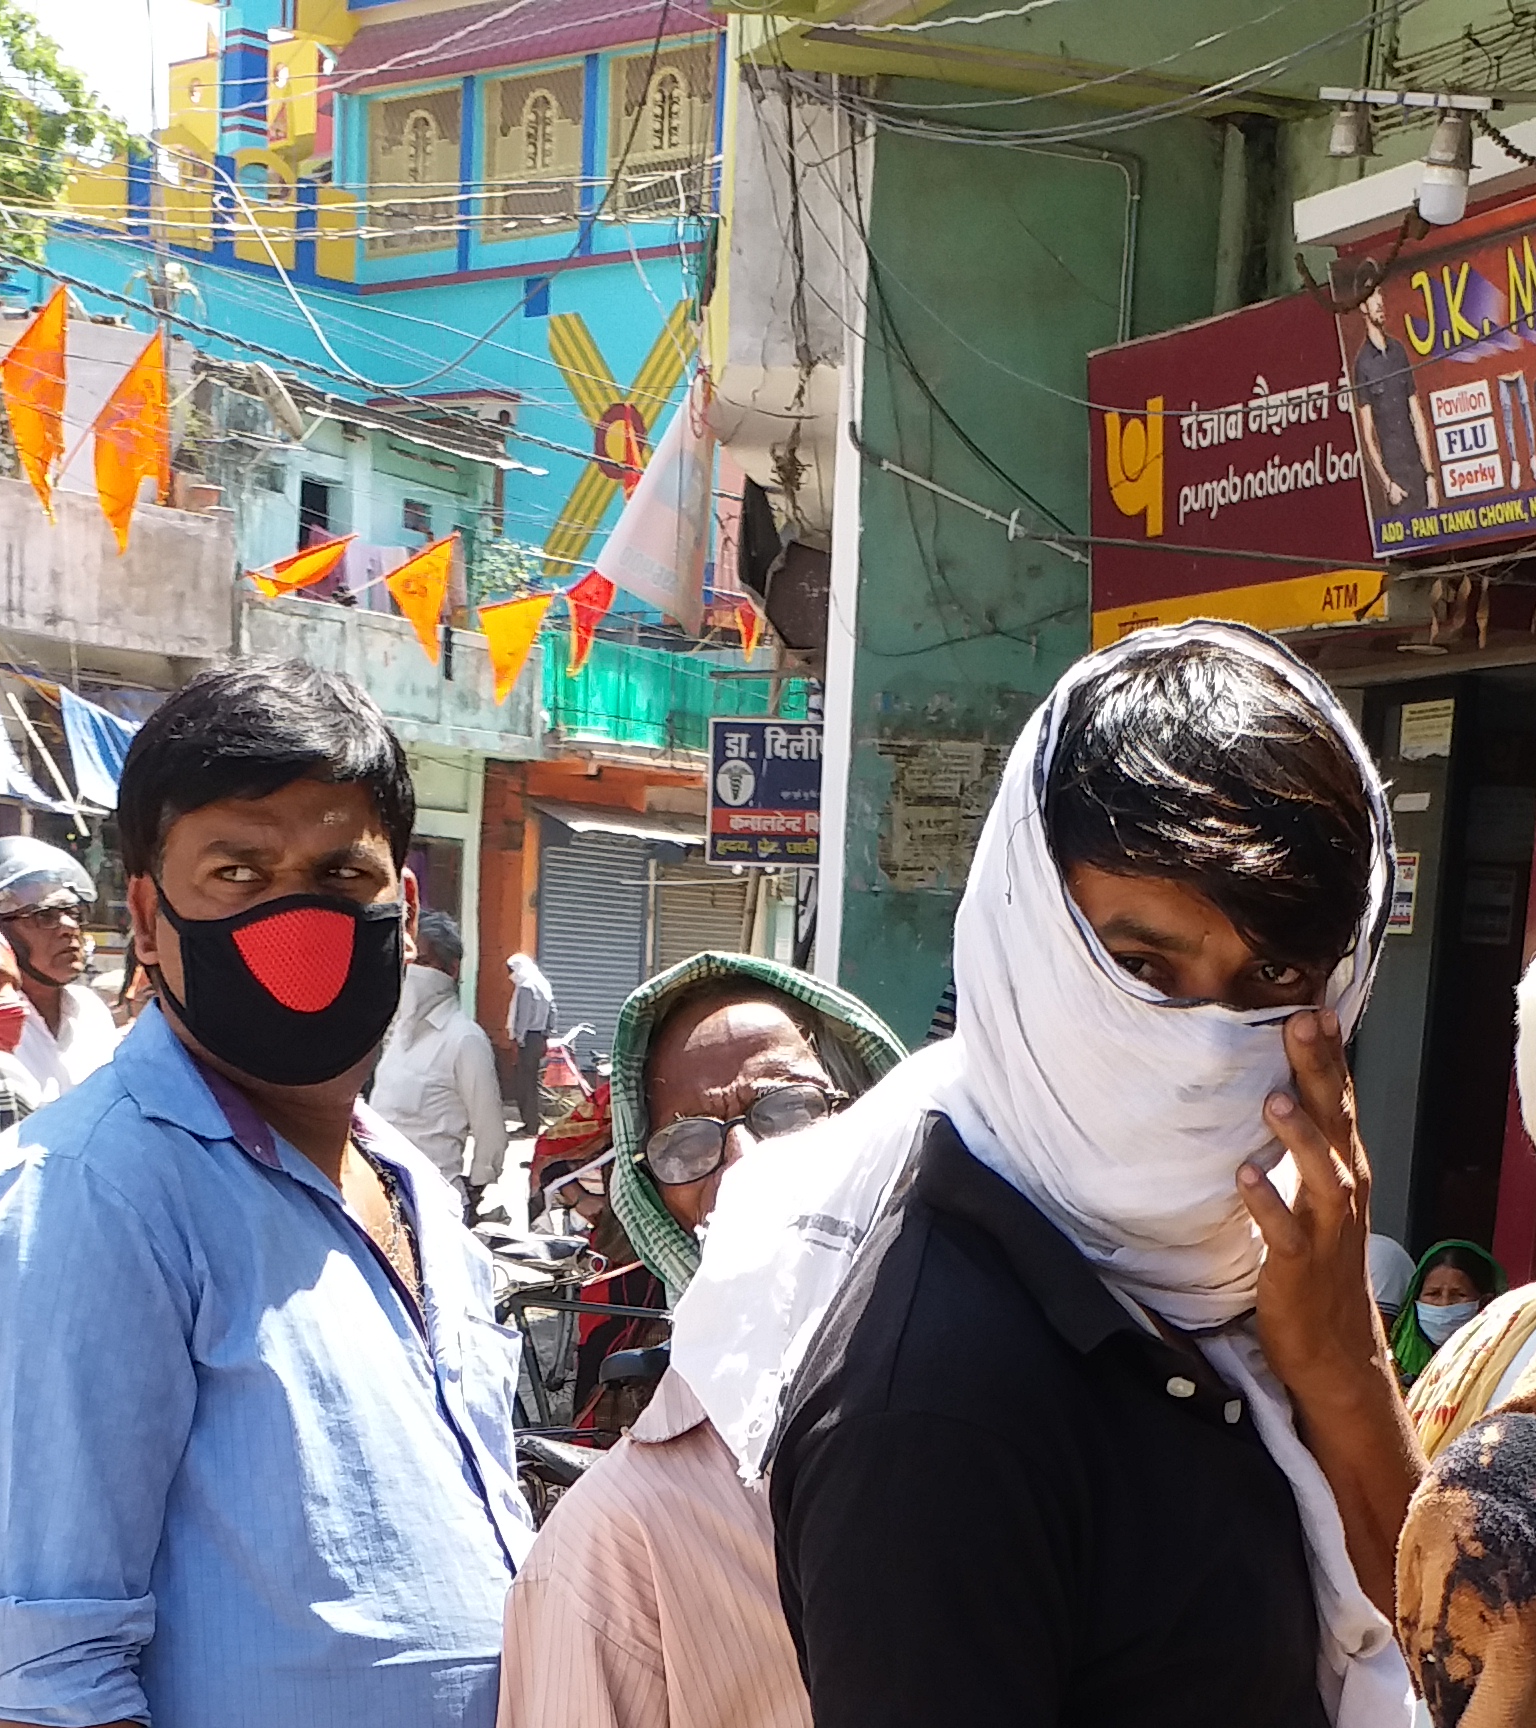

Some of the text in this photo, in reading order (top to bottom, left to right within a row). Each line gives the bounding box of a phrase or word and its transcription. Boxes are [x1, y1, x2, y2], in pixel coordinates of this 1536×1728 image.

[1404, 262, 1491, 356] J.K.
[1436, 391, 1486, 418] Pavilion
[1179, 401, 1243, 450] पंजाब
[1444, 424, 1487, 455] FLU
[1178, 441, 1362, 526] punjab national ban
[1449, 463, 1495, 491] Sparky
[1381, 523, 1404, 544] ADD
[1411, 515, 1438, 539] PANI
[1440, 510, 1477, 534] TANKI
[1479, 501, 1529, 527] CHOWK,
[1322, 583, 1359, 611] ATM
[724, 726, 823, 760] डा. दिली
